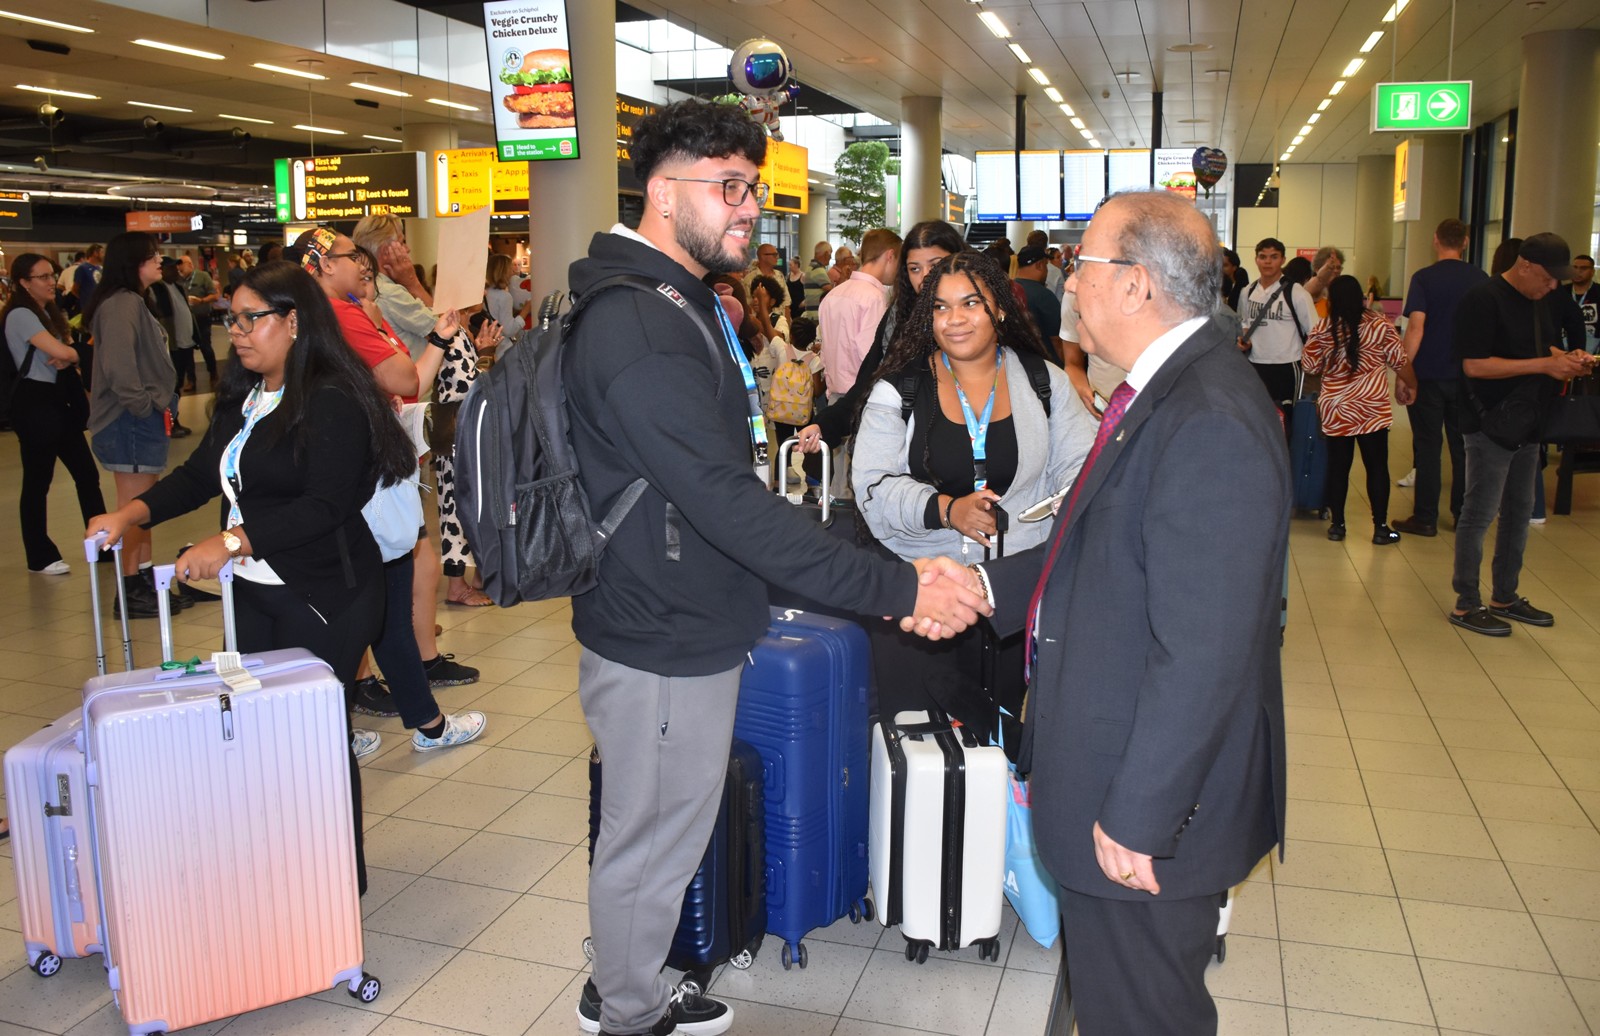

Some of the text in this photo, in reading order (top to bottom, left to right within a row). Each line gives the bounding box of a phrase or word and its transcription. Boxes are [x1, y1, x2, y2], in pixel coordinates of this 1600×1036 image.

[519, 6, 539, 14] Schiphol
[491, 13, 558, 28] Veggie Crunchy
[492, 26, 558, 38] Chicken Deluxe
[460, 150, 488, 158] Arrivals
[315, 156, 341, 165] First aid
[315, 175, 370, 186] Baggage storage
[316, 191, 348, 200] Car rental
[366, 188, 409, 199] Lost & found
[317, 206, 363, 217] Meeting point
[389, 205, 411, 214] Toilets
